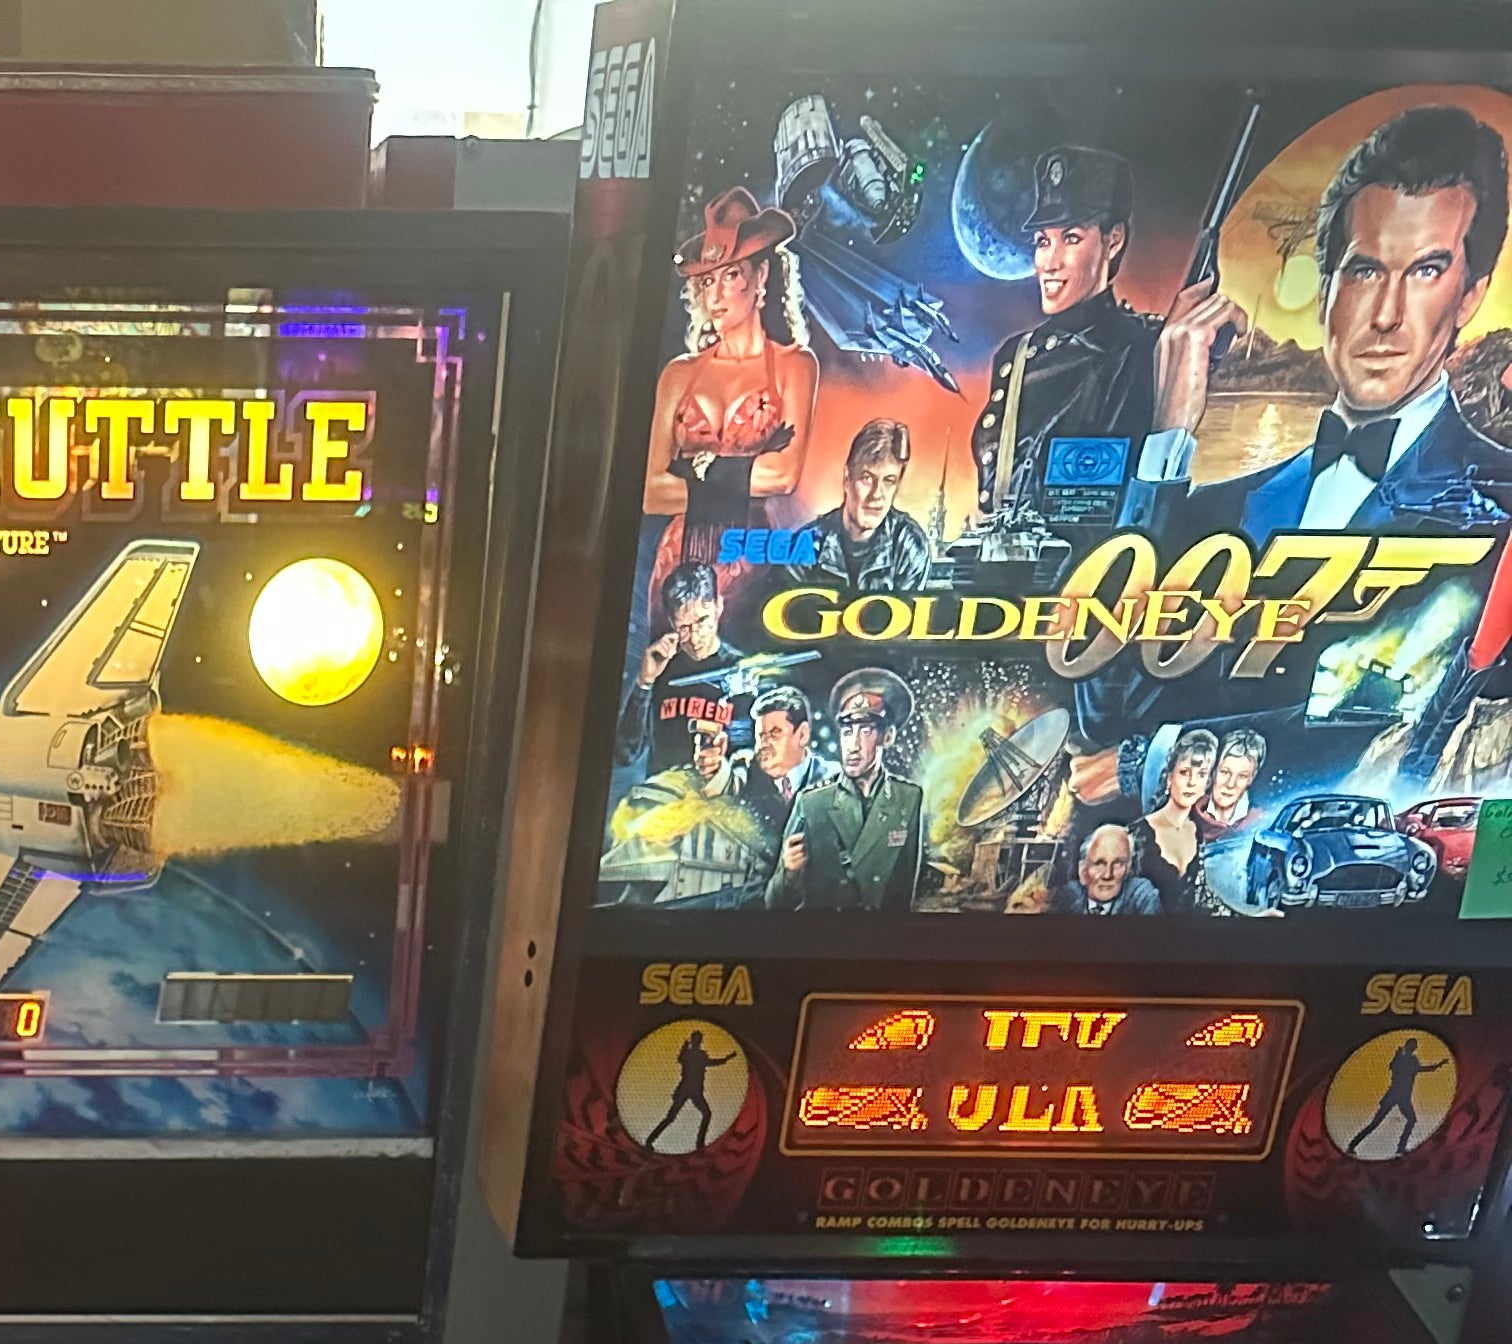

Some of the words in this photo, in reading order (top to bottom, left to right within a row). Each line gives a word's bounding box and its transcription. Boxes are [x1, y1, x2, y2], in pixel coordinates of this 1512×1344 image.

[580, 36, 656, 178] SEGA
[718, 528, 821, 566] SEGA
[1044, 532, 1494, 681] 007
[659, 696, 735, 725] WIRED
[639, 963, 754, 1007] SEGA
[1360, 973, 1474, 1017] SEGA
[17, 1001, 42, 1038] 0
[823, 1173, 1214, 1205] GOLDENEYE
[815, 1215, 863, 1229] RAMP
[866, 1216, 934, 1230] COMBOS
[937, 1216, 982, 1230] SPELL
[985, 1217, 1076, 1231] GOLDENEYE
[1079, 1218, 1111, 1231] FOR
[1114, 1218, 1205, 1232] HURRY-UPS
